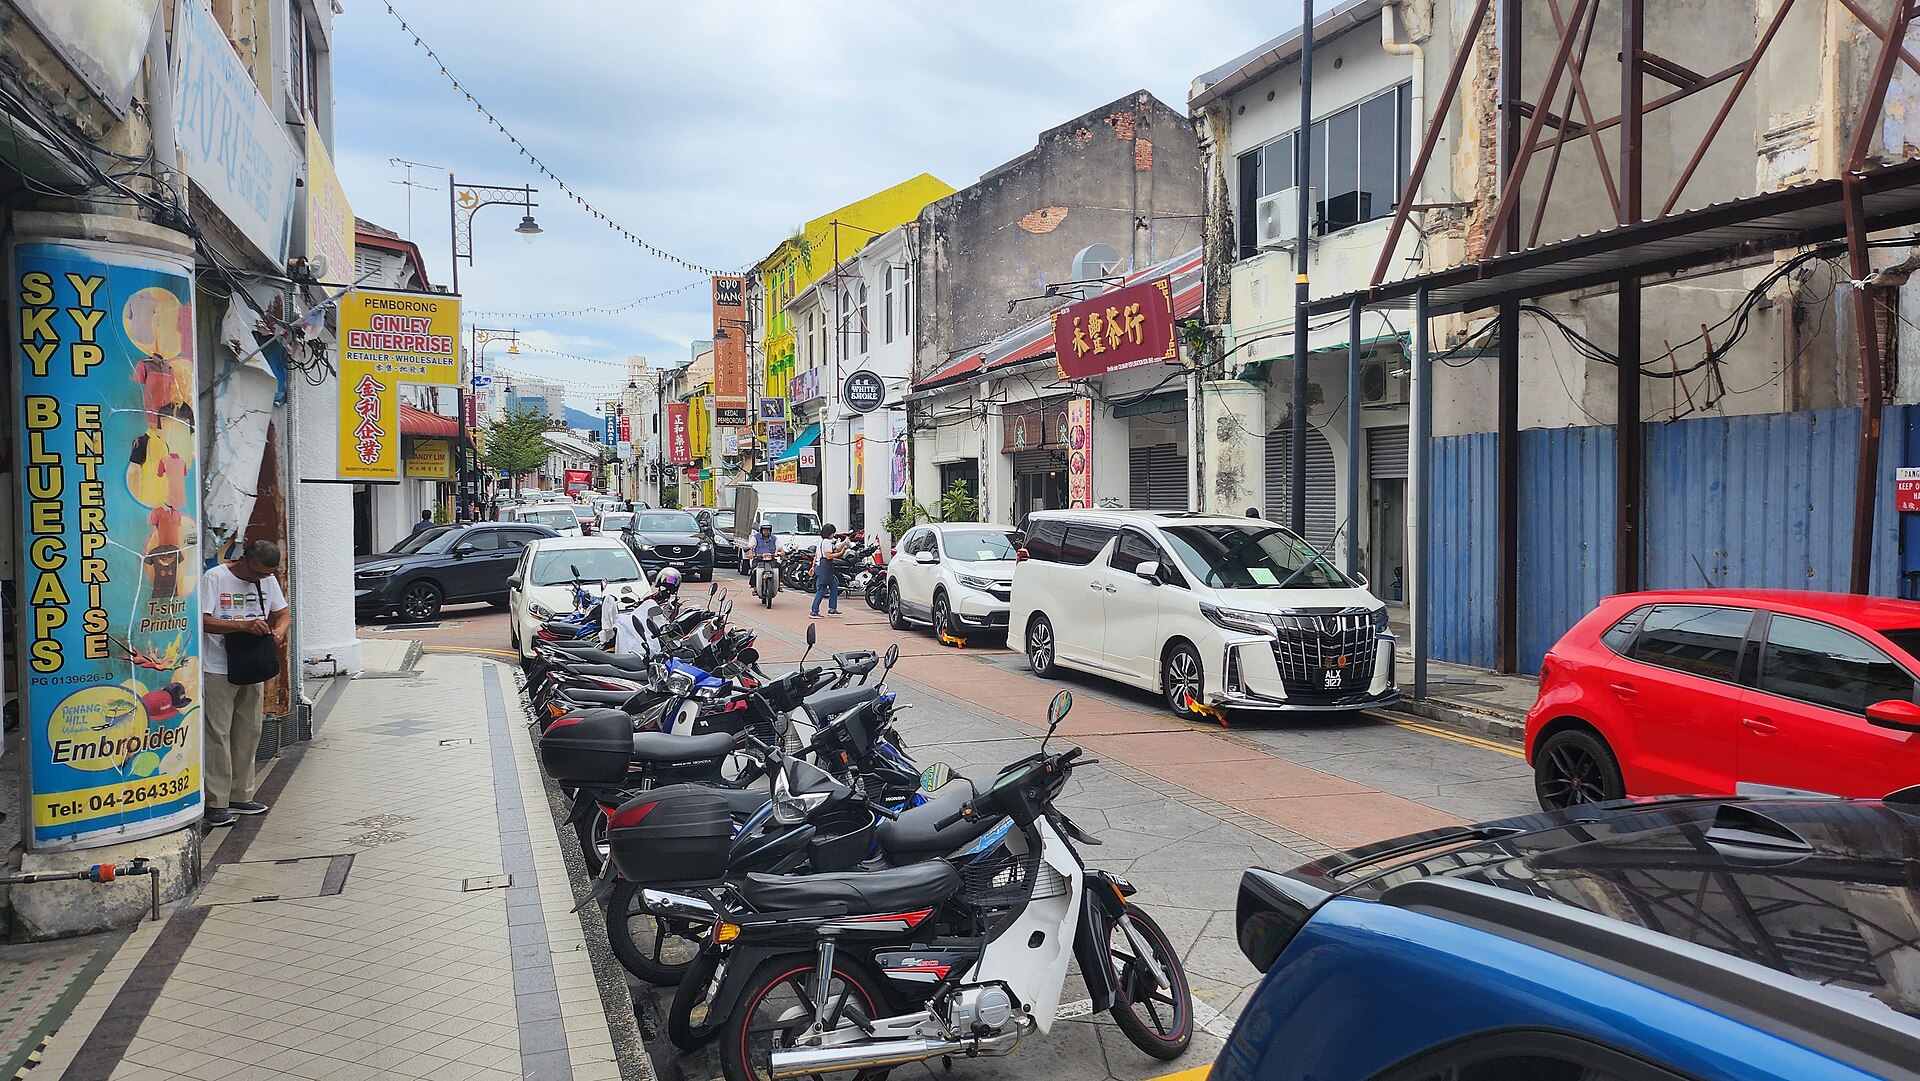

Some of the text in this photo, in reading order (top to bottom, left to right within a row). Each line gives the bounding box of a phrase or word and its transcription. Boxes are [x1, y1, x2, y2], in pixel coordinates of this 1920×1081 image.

[364, 298, 438, 312] PEMBORONG
[371, 314, 432, 334] GINLEY
[348, 330, 452, 354] ENTERPRISE
[346, 352, 454, 365] RETAILER WHOLESALER
[354, 374, 386, 464] 金利企業
[64, 273, 109, 660] YYP ENTERPRISE
[801, 454, 814, 464] 96
[22, 272, 69, 672] SKY BLUECAPS
[1898, 482, 1913, 490] KEEP
[148, 600, 186, 616] T-shirt
[140, 616, 188, 633] Printing
[32, 672, 114, 686] PG 0139626-D
[1325, 670, 1342, 678] ALX
[1324, 678, 1342, 687] 3127
[62, 704, 100, 718] PENANG
[52, 724, 190, 764] Embroidery
[48, 775, 190, 818] Tel: 04-2643382
